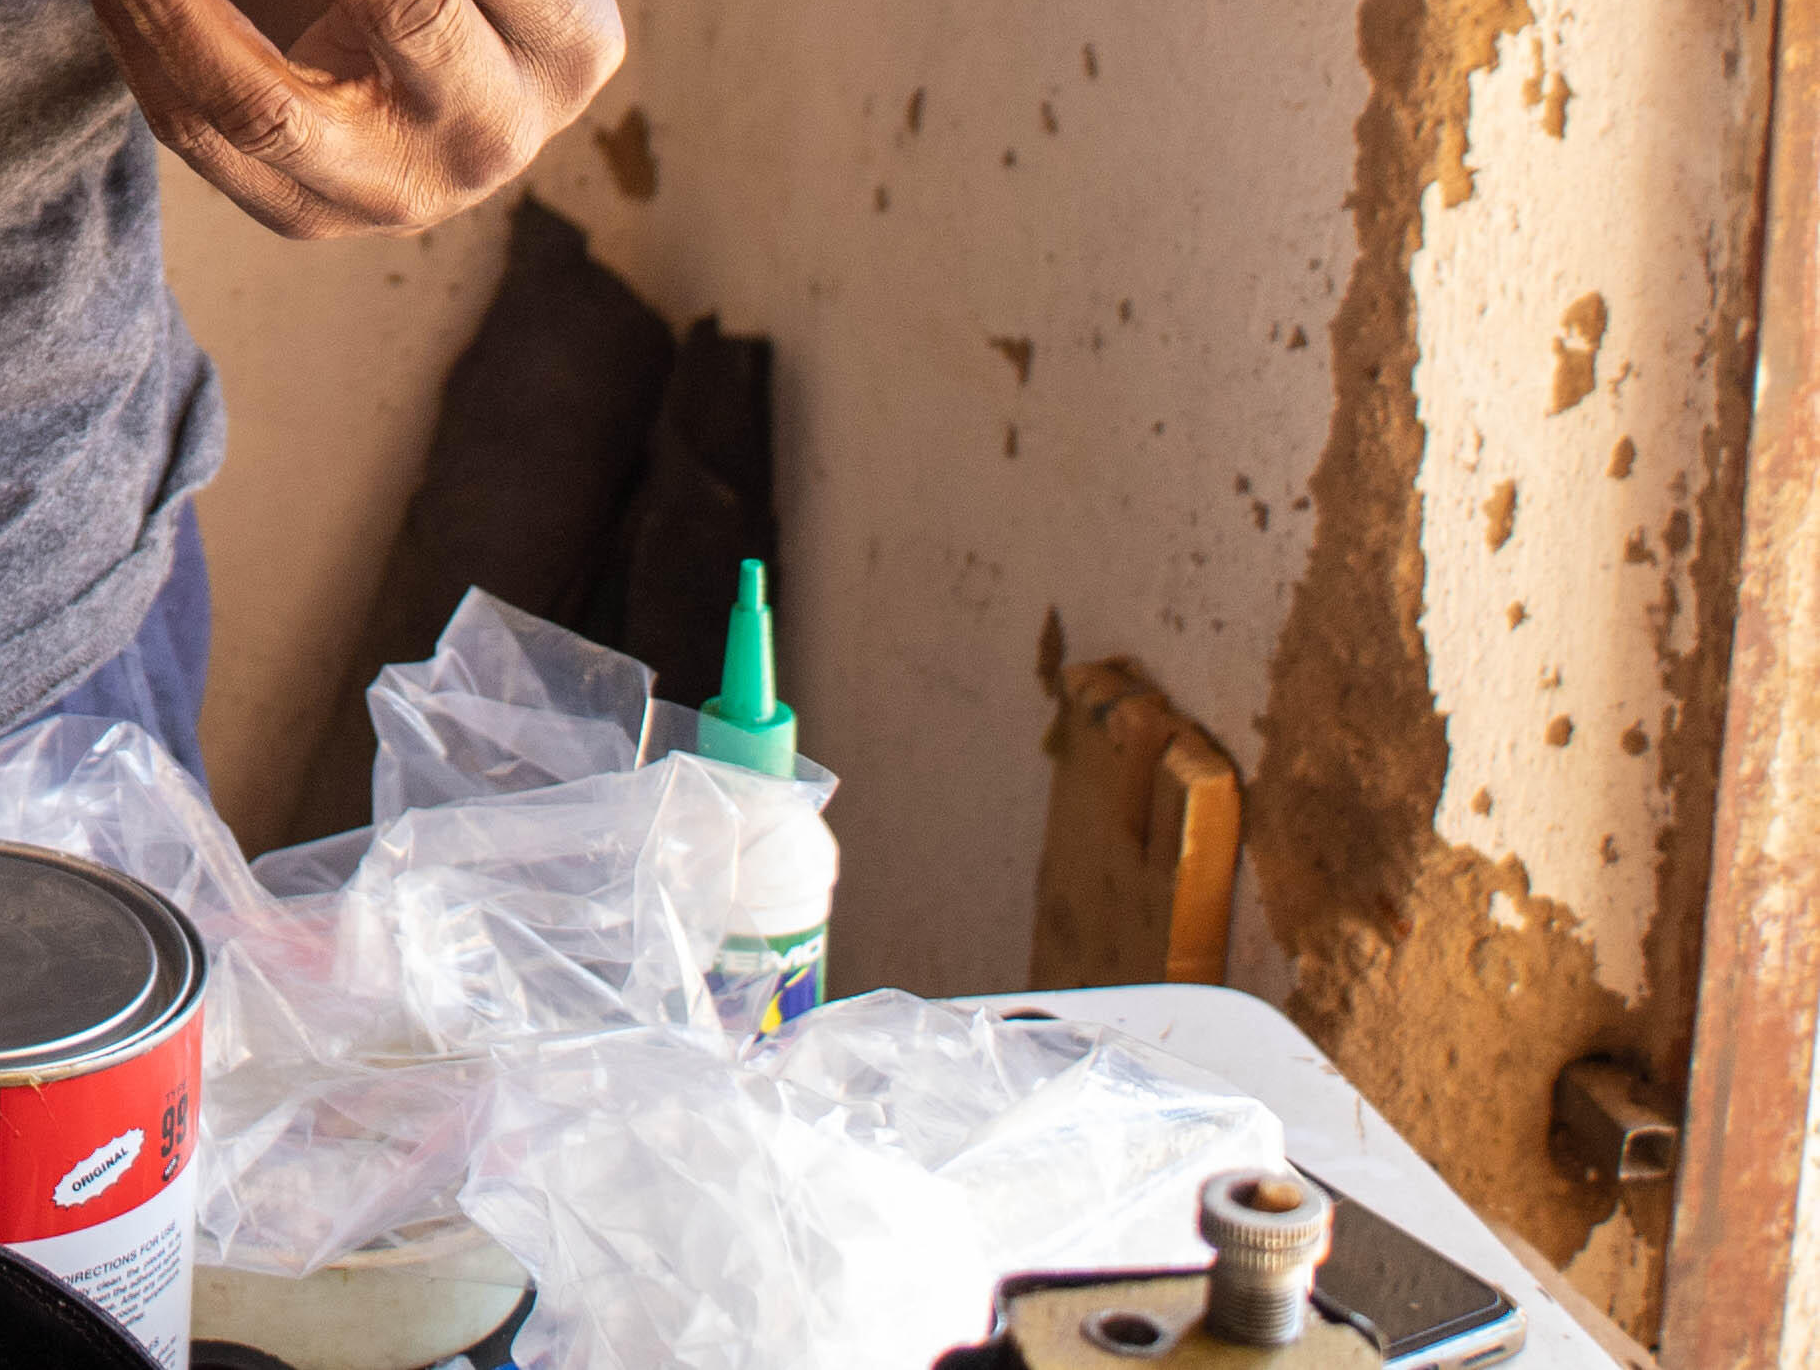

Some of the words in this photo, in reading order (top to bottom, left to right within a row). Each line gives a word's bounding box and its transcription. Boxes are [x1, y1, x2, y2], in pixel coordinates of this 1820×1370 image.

[161, 1092, 188, 1158] 99
[72, 1147, 129, 1192] ORIGINAL
[62, 1249, 137, 1285] DIRECTIONS
[140, 1235, 159, 1255] FOR
